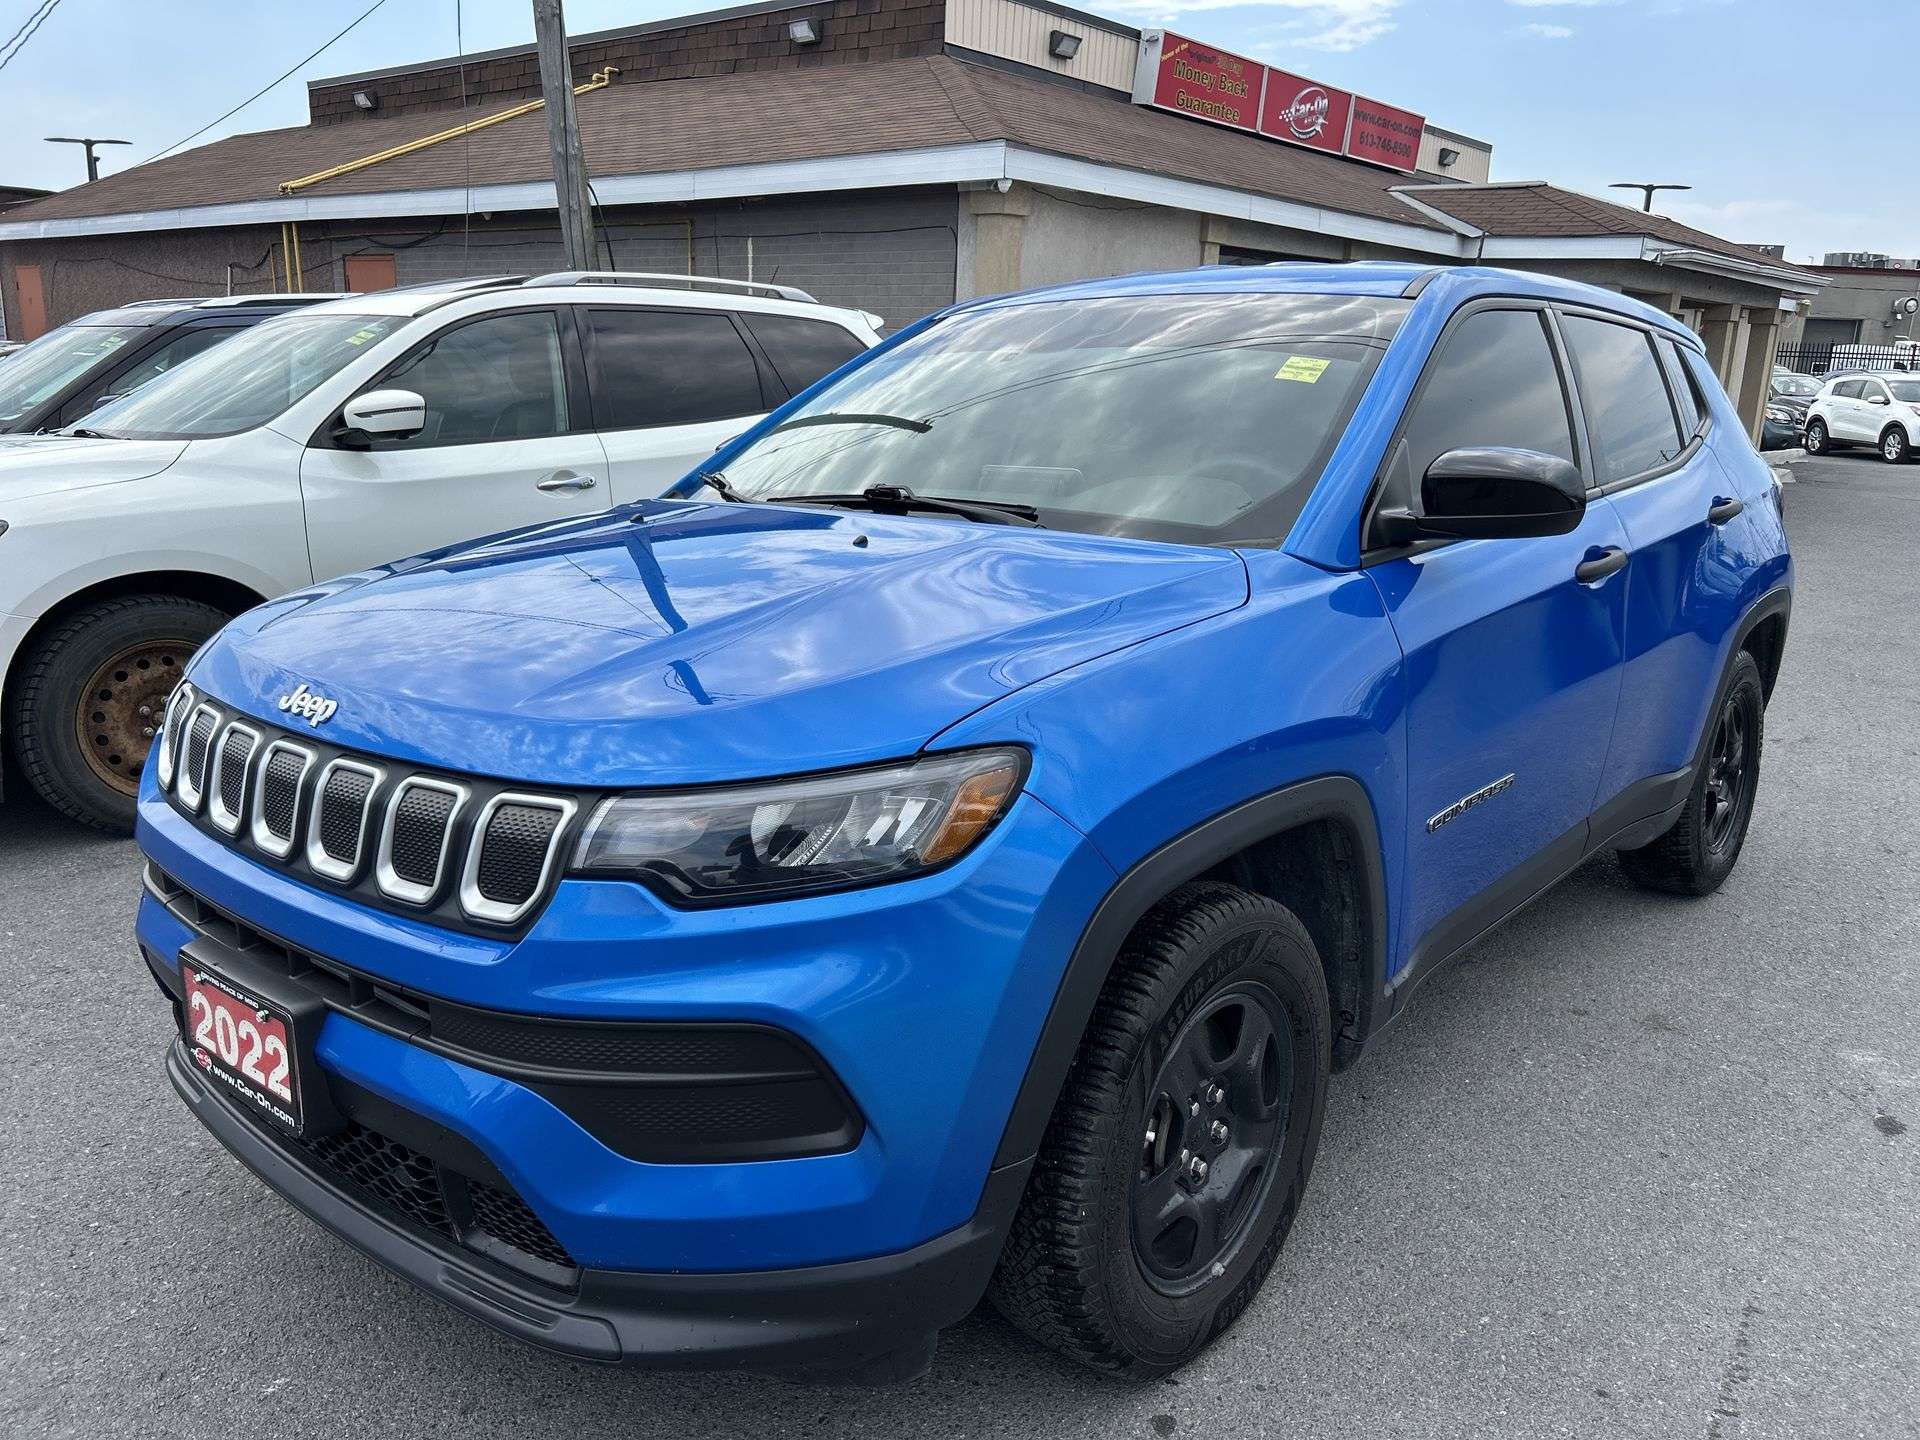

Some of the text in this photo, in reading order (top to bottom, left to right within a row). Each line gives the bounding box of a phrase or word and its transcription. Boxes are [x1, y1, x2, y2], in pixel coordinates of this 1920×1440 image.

[1173, 58, 1217, 92] Money
[1218, 72, 1248, 98] Back
[1176, 88, 1240, 122] Guarantee
[279, 684, 338, 728] Jeep
[1427, 773, 1515, 833] COMPASS
[219, 982, 237, 997] PEACE
[236, 992, 245, 1001] OF
[244, 996, 259, 1009] MIND
[191, 990, 292, 1103] 2022
[212, 1064, 295, 1127] www.Car-On.com
